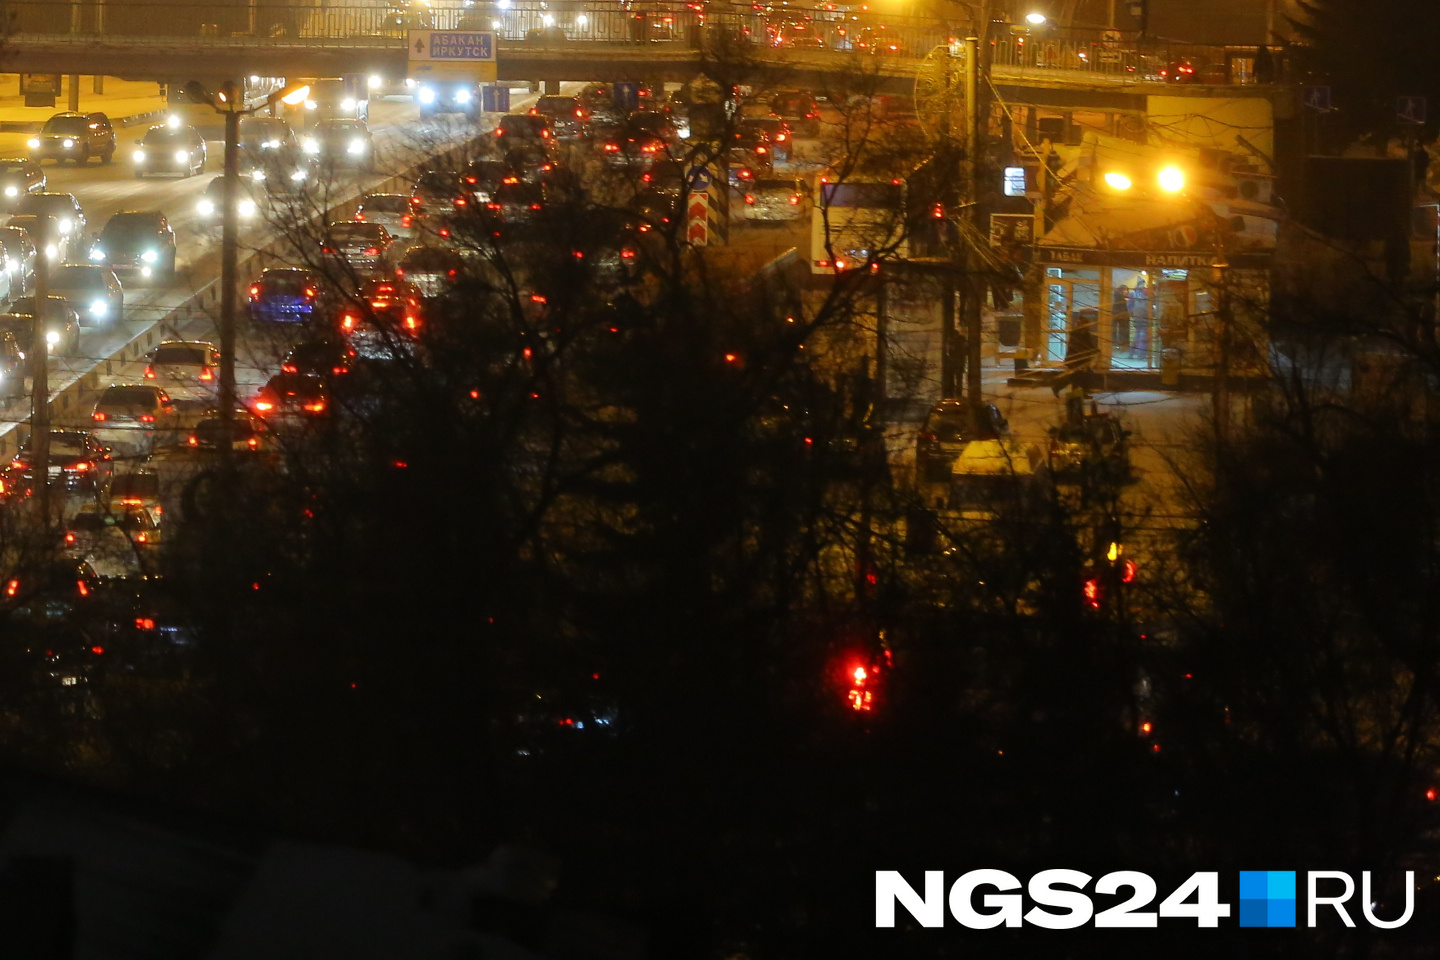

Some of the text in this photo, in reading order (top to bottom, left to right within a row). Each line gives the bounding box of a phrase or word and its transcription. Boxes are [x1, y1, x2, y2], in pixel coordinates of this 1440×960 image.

[433, 35, 483, 46] АБАКАН
[432, 46, 488, 57] ИРКУТСК
[1050, 250, 1083, 262] ТАБАК
